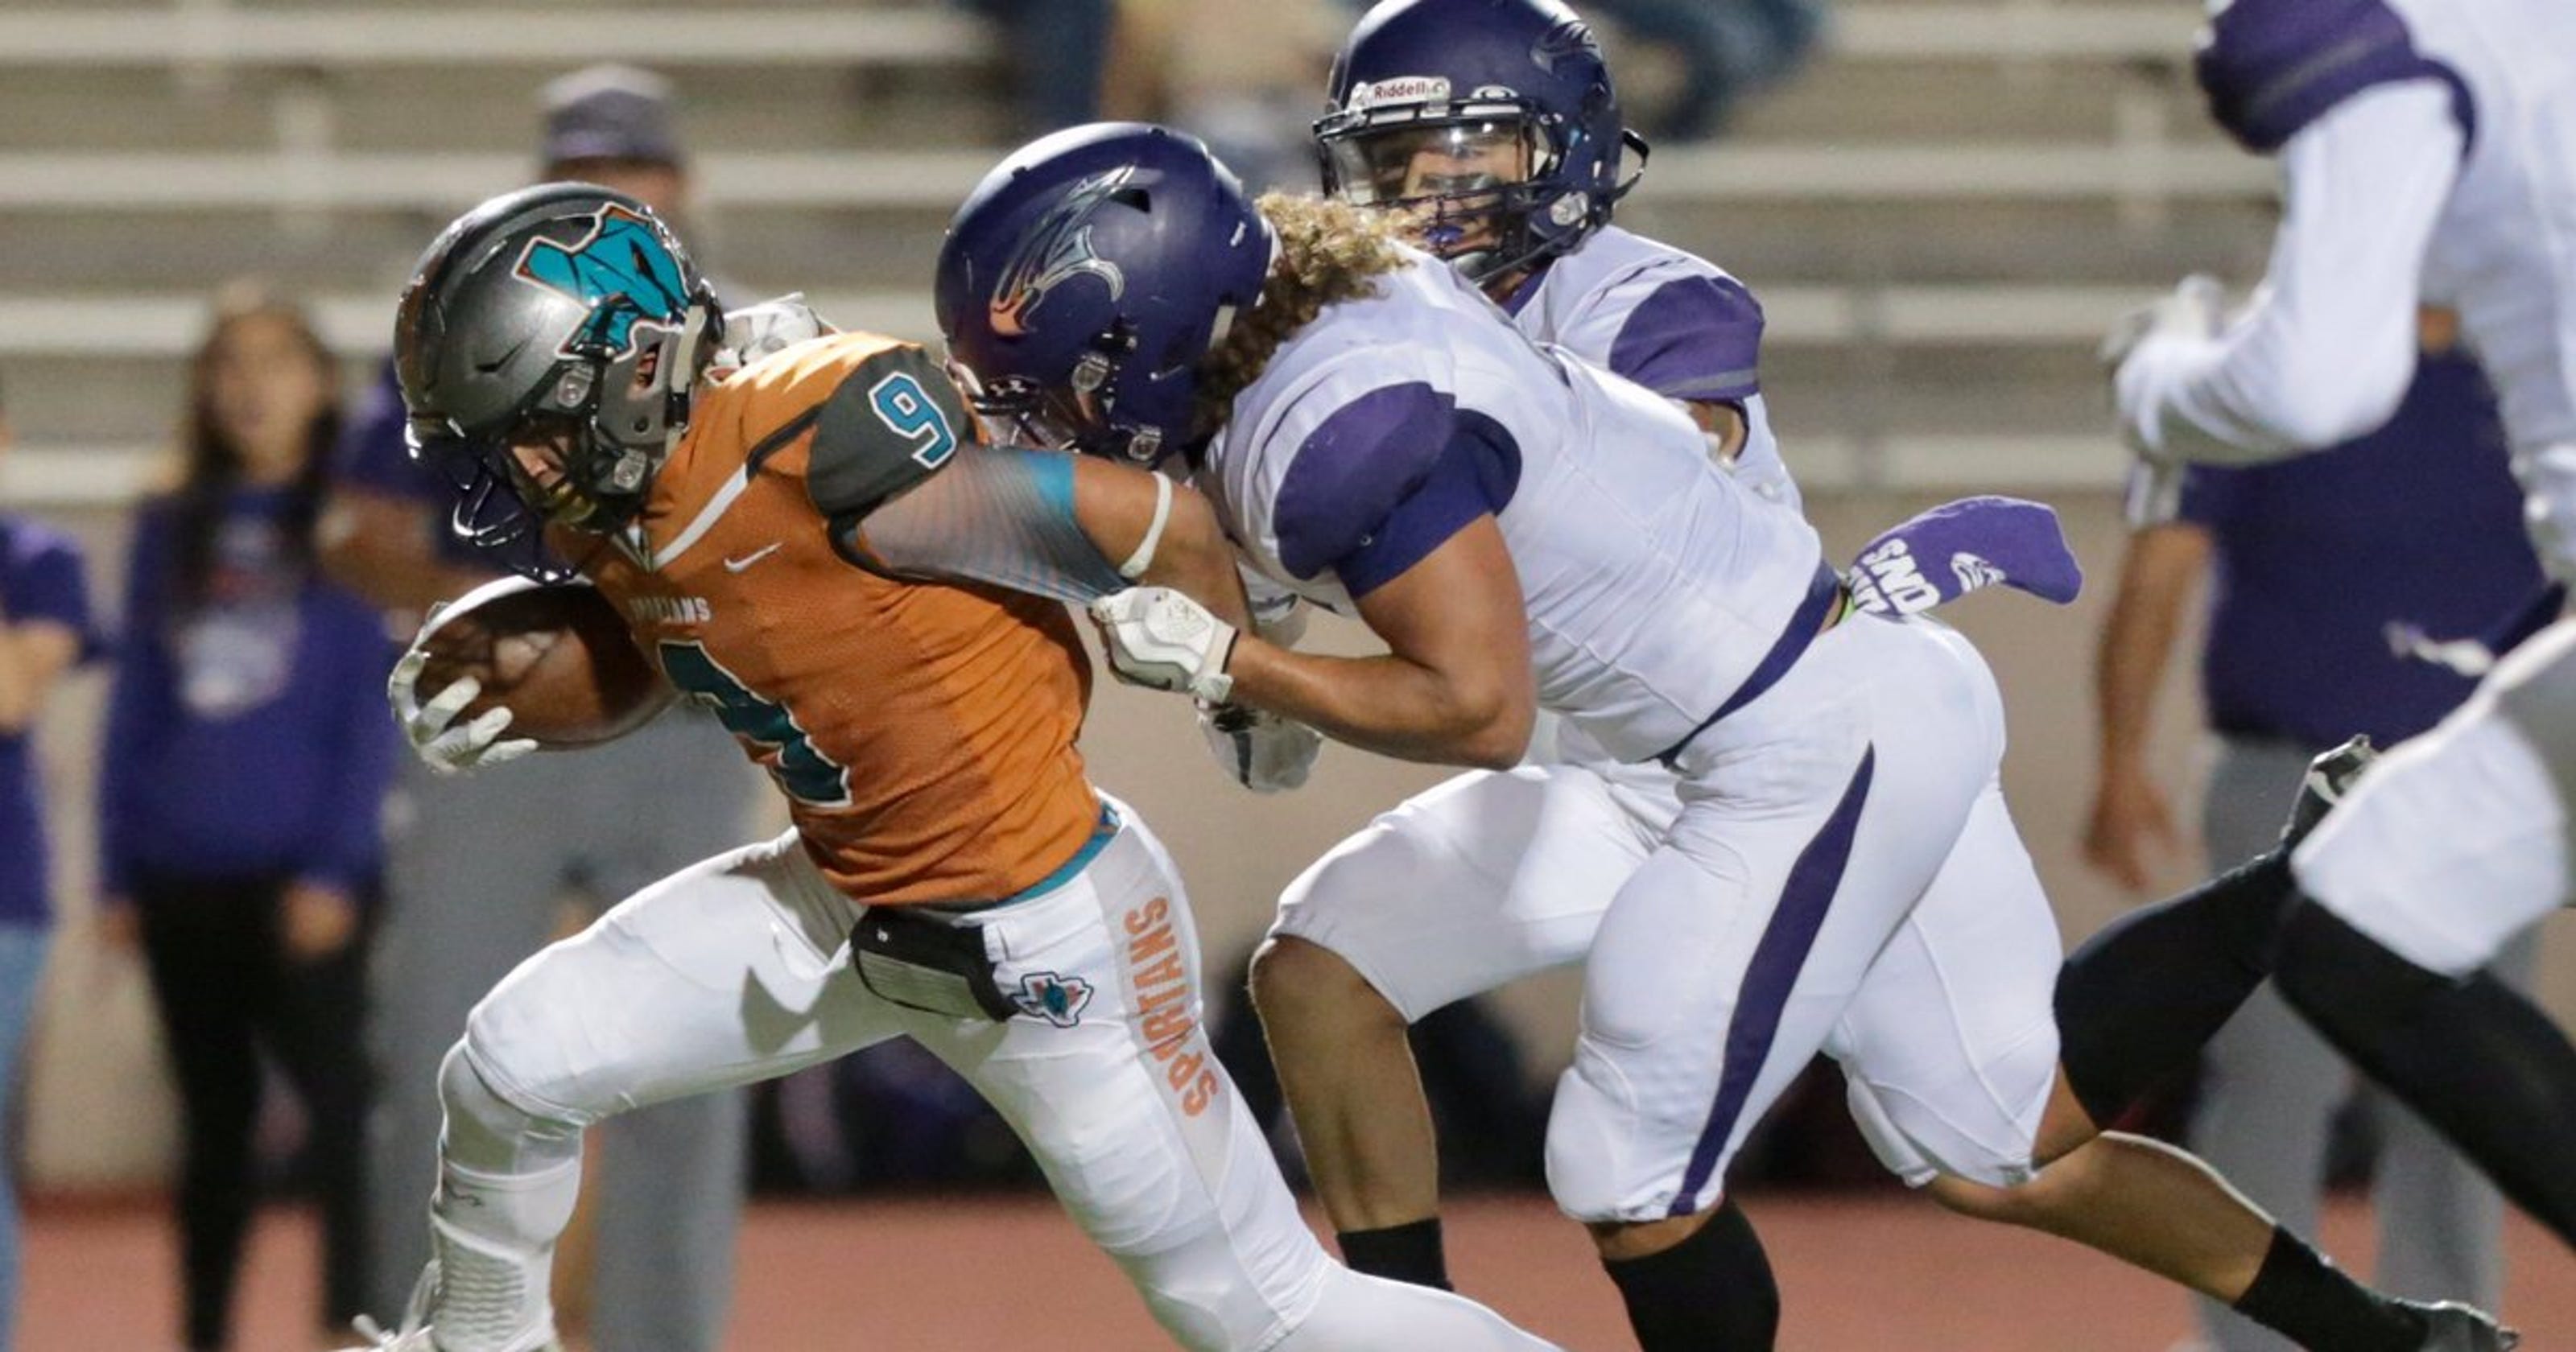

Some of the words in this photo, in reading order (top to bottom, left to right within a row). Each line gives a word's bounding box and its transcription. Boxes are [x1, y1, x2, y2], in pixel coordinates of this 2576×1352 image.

[1374, 80, 1426, 100] Riddell
[867, 370, 956, 469] 9
[1124, 895, 1220, 1118] SPARTANS
